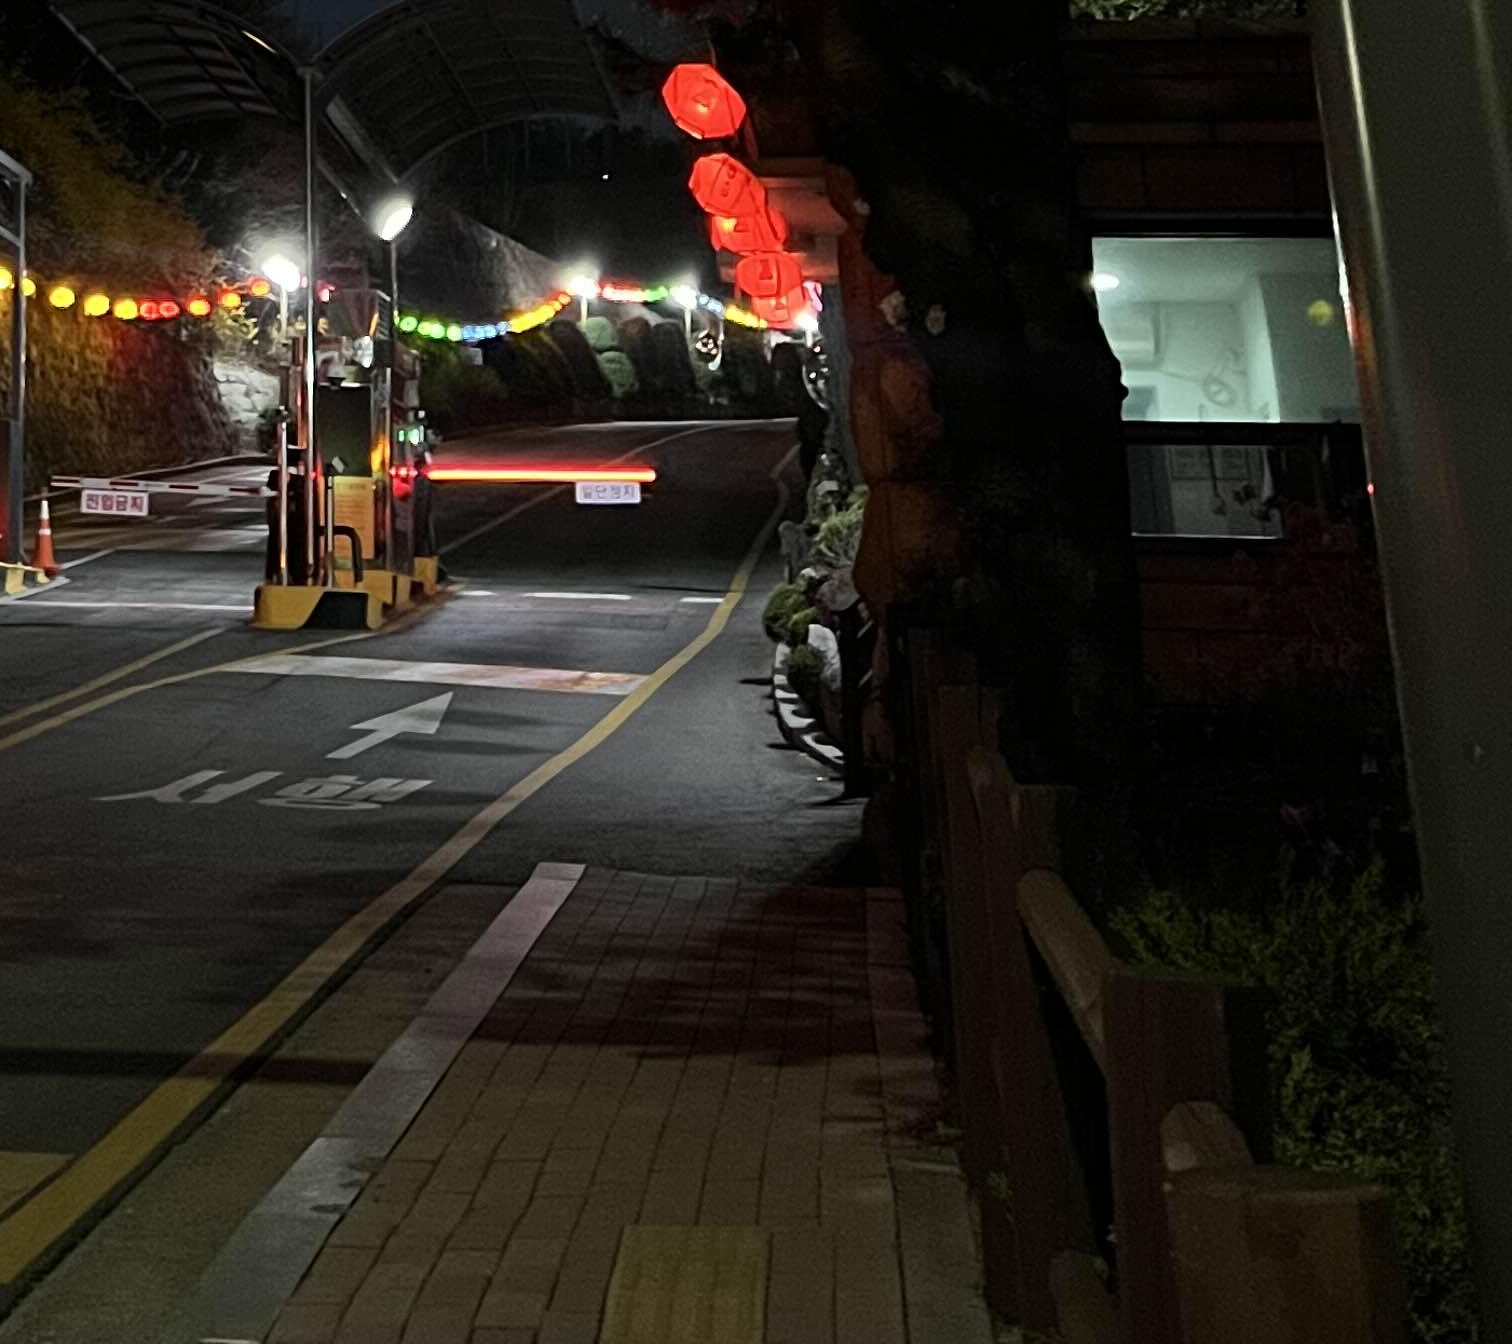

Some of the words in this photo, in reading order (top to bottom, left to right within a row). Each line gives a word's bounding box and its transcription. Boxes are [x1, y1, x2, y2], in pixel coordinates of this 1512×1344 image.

[582, 484, 635, 500] 일단정지
[86, 493, 144, 513] 진입금지
[91, 768, 435, 811] 서행
